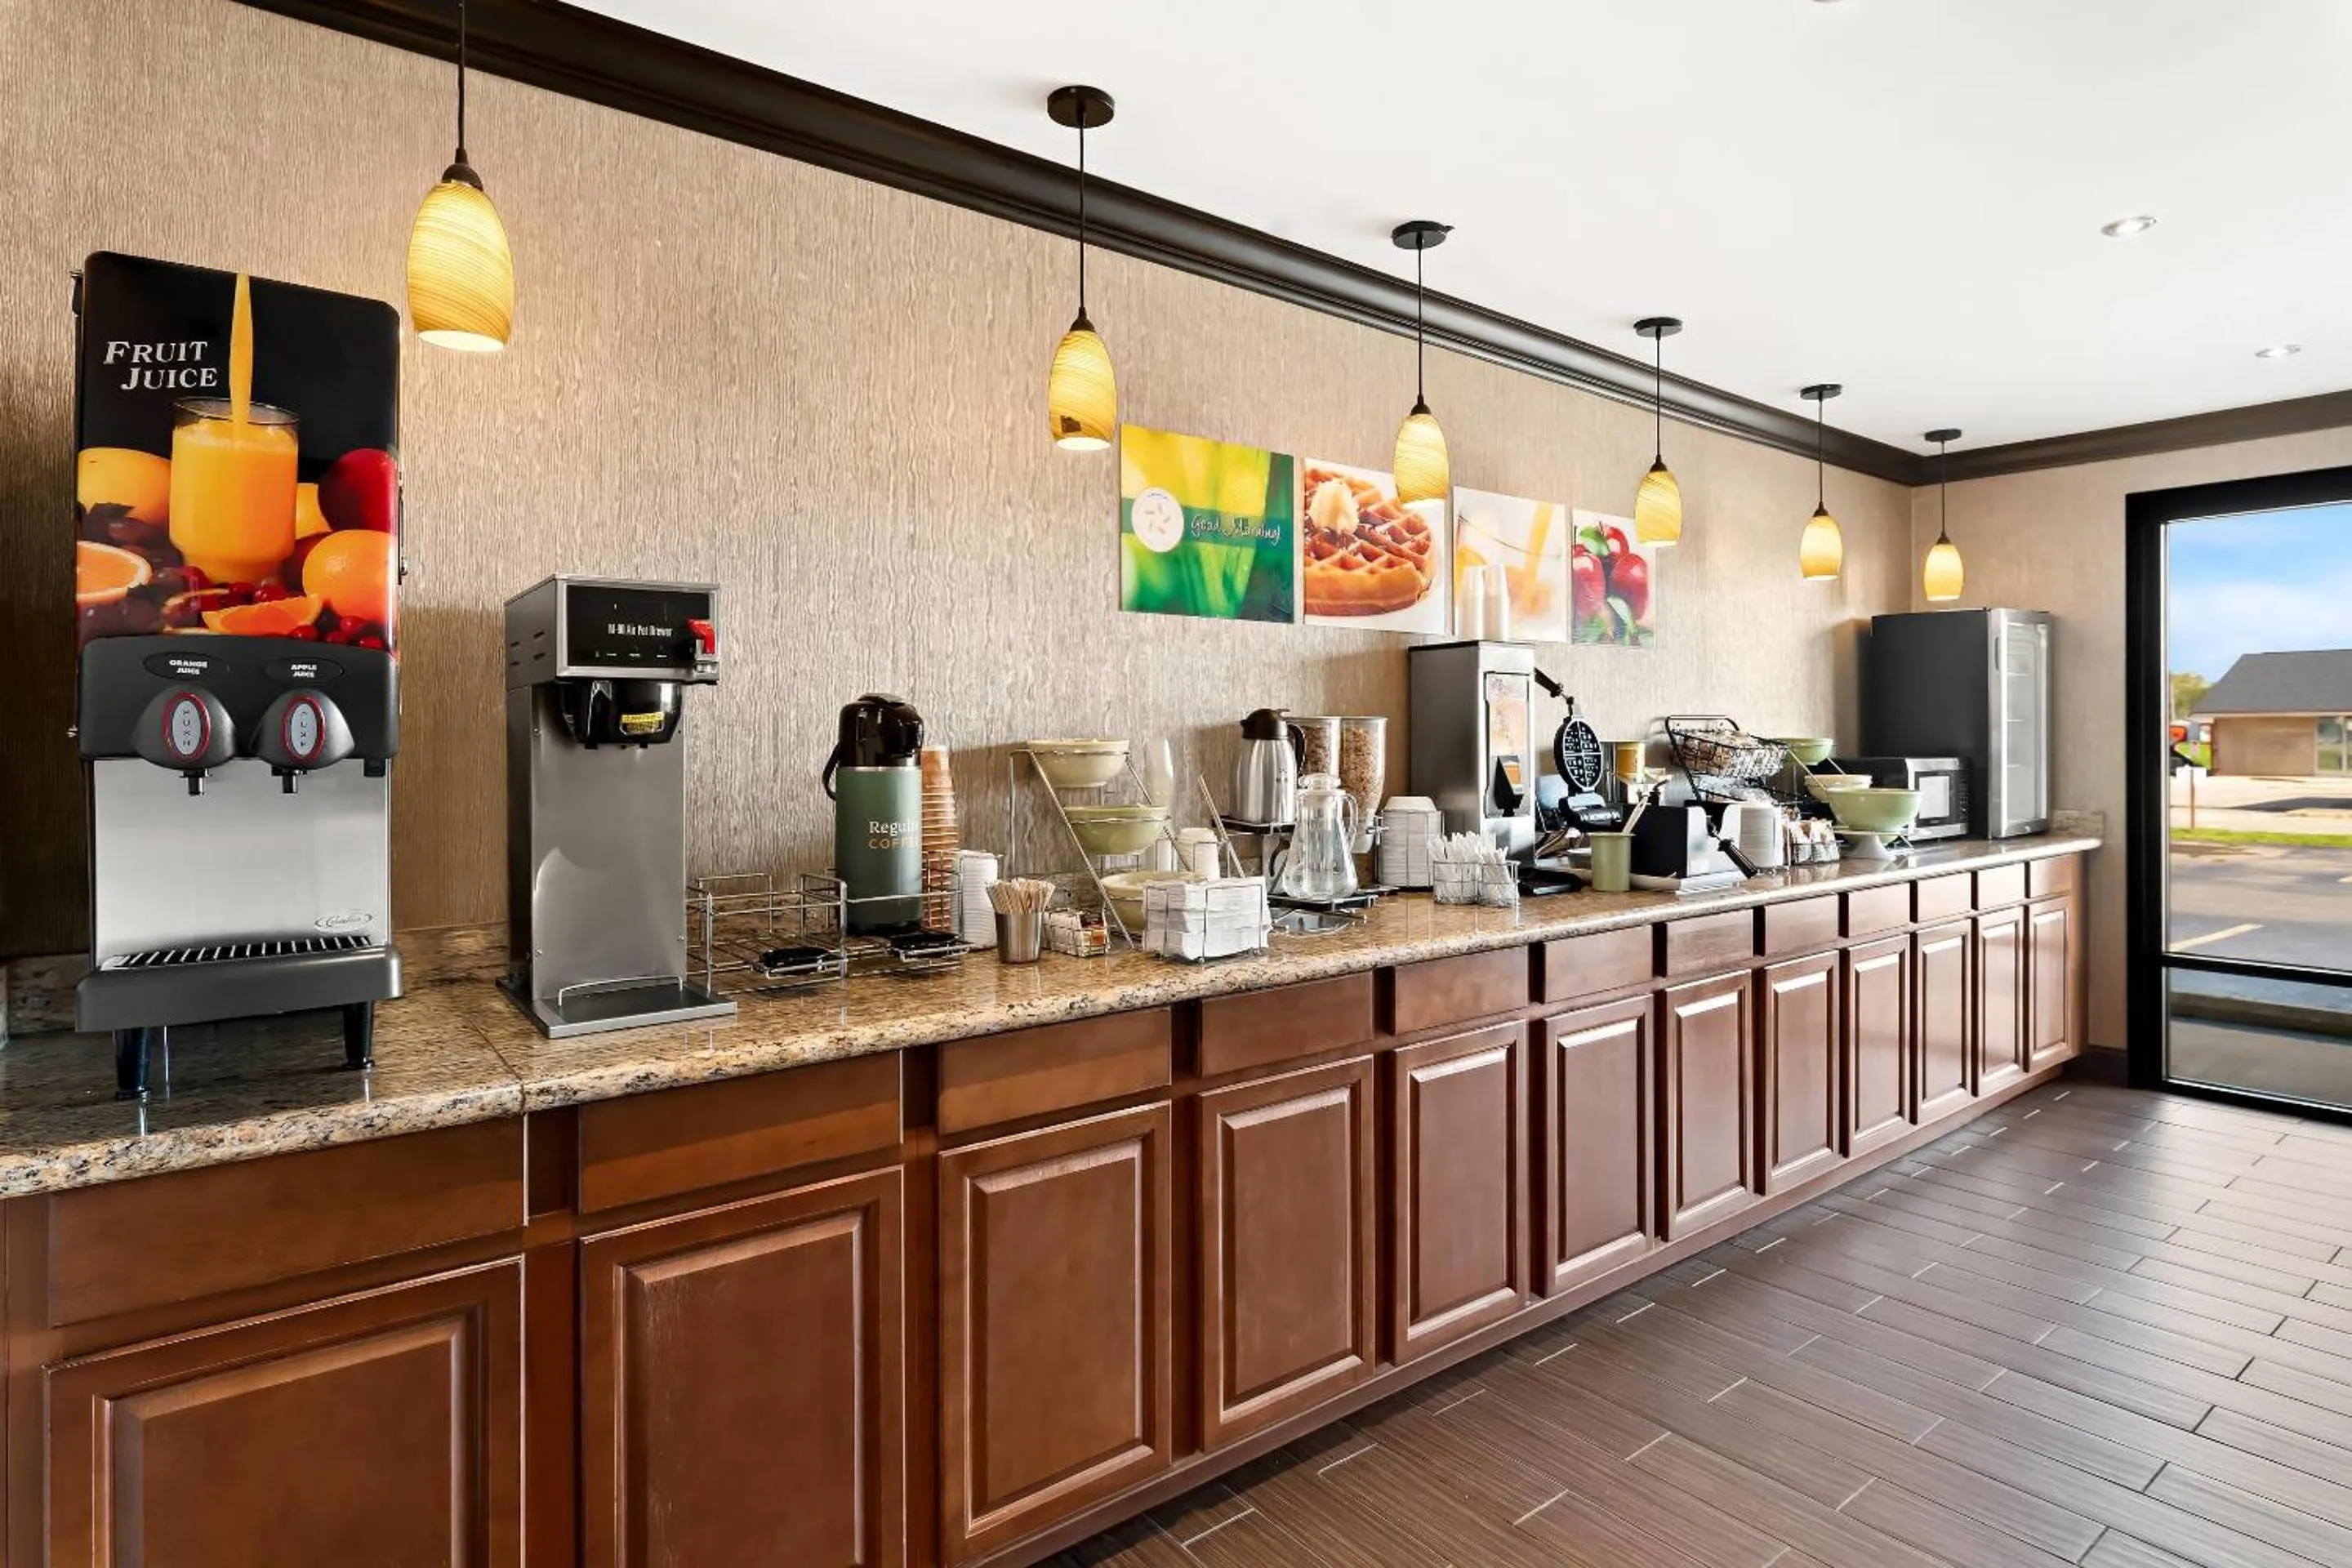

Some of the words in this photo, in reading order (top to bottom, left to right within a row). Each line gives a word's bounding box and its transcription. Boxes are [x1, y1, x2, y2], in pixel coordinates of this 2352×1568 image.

[103, 341, 207, 364] FRUIT
[121, 368, 217, 390] JUICE
[169, 660, 207, 668] ORANGE
